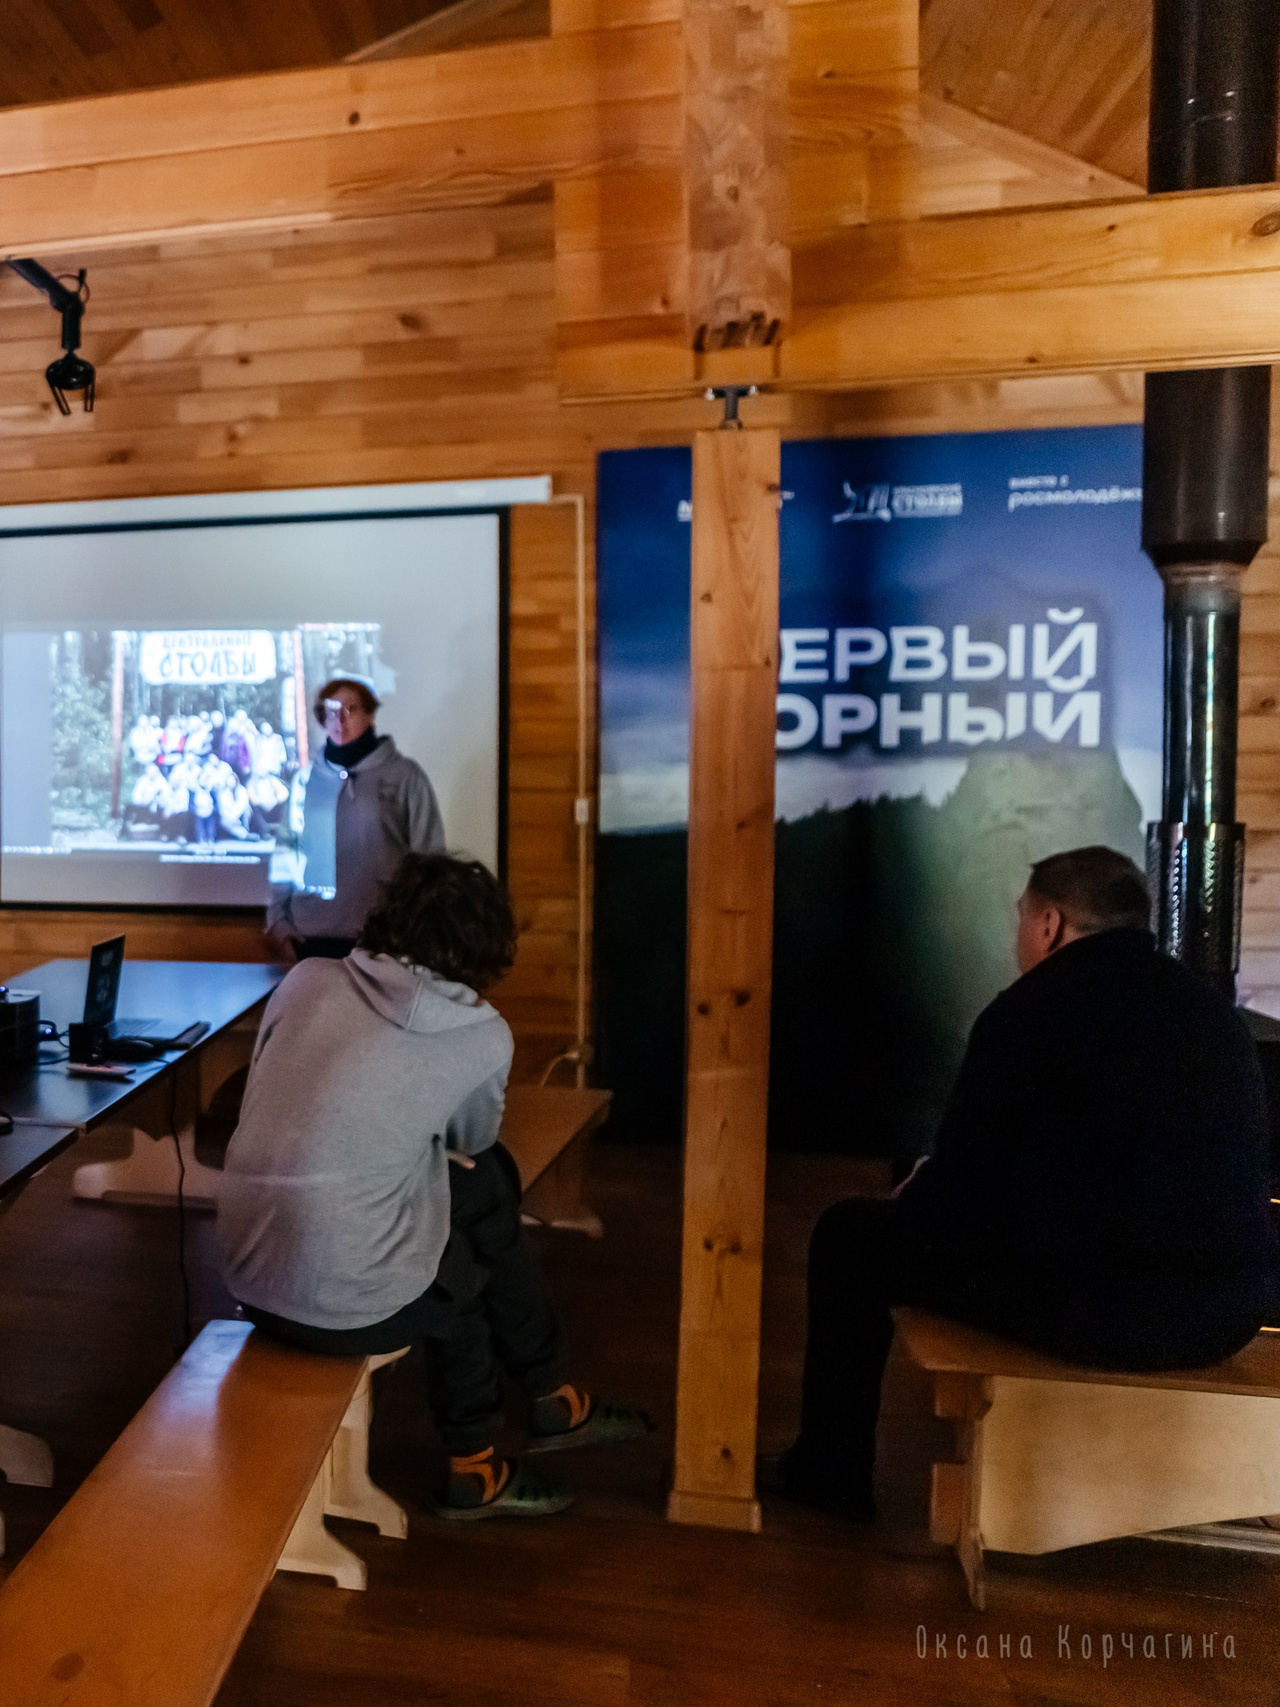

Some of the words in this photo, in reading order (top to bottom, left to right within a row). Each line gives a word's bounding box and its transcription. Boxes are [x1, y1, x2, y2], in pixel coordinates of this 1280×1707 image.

[160, 650, 257, 678] СТОЛБЫ
[779, 607, 1098, 684] ЕРВЫЙ
[775, 674, 1102, 748] ОРНЫЙ
